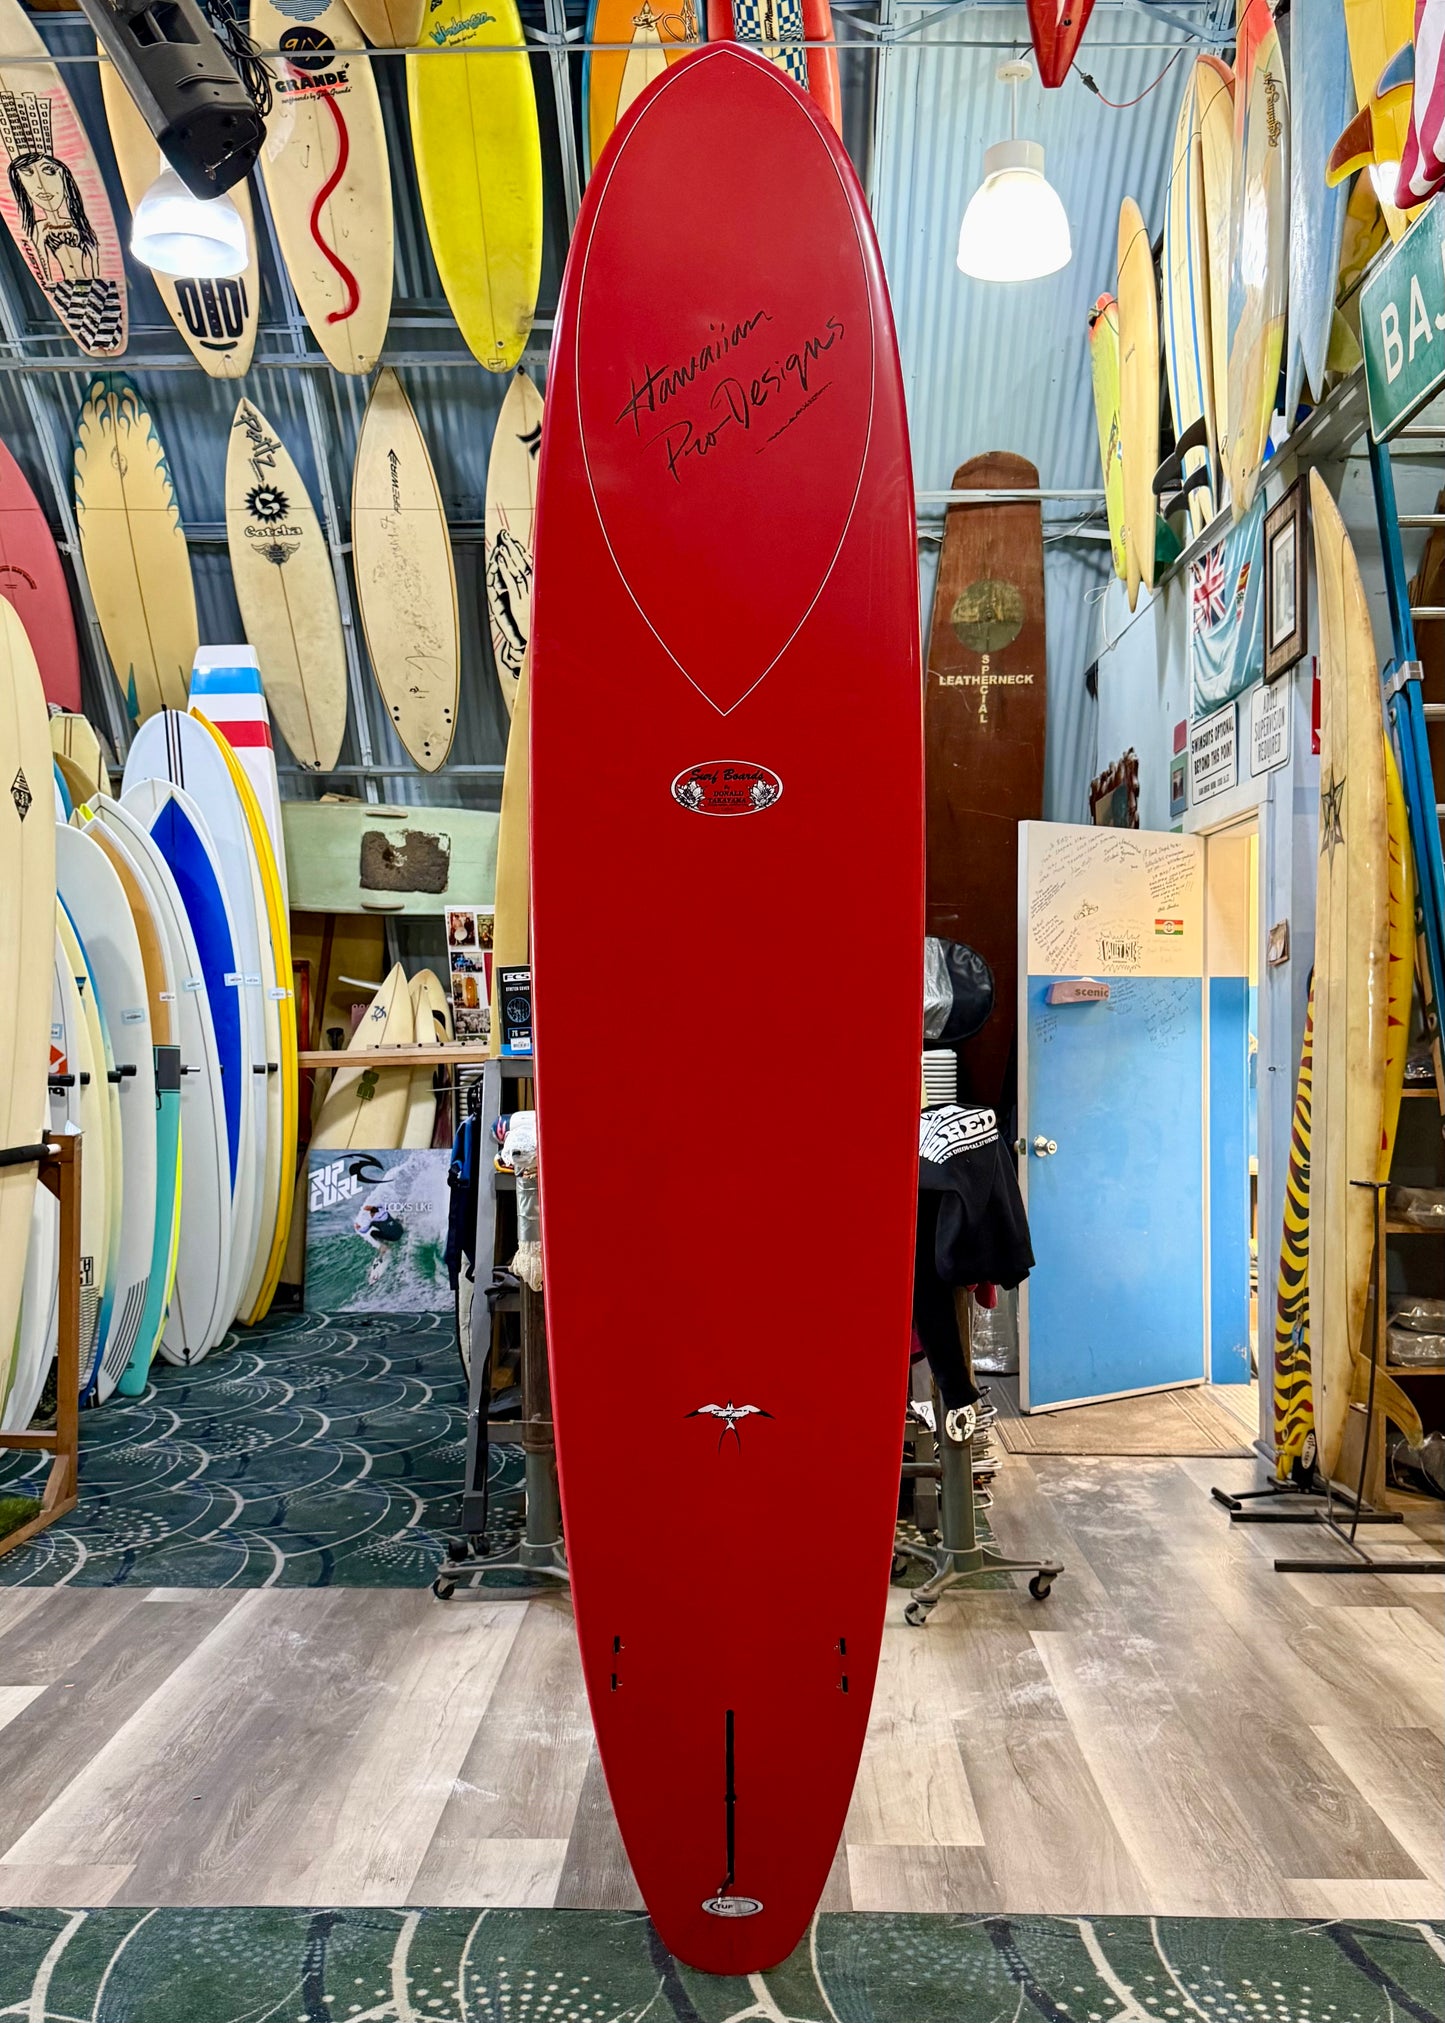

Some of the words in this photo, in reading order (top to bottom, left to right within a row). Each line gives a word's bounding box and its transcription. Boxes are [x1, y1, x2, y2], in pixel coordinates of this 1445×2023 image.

[275, 70, 349, 93] GRANDE
[21, 239, 49, 291] KUSTOM
[615, 309, 774, 437] Hawaiian
[244, 524, 304, 538] Gotcha
[939, 674, 1034, 686] LEATHERNECK
[977, 654, 990, 724] SPECIAL
[1263, 687, 1279, 714] ADULT
[1191, 729, 1214, 755] SWIMSUITS
[1214, 716, 1235, 742] OPTIONAL
[1254, 705, 1286, 743] SUPERVISION
[1194, 751, 1210, 776] BEYOND
[1210, 747, 1220, 767] THIS
[1220, 740, 1233, 761] POINT
[1257, 732, 1281, 763] REQUIRED
[689, 768, 719, 785] Surf
[724, 768, 764, 781] Boards
[504, 973, 530, 981] FCS
[1074, 986, 1109, 999] scenic
[308, 1159, 345, 1191] RIP
[310, 1174, 364, 1213] CURL
[384, 1202, 413, 1213] LOOKS
[415, 1202, 433, 1212] LIKE
